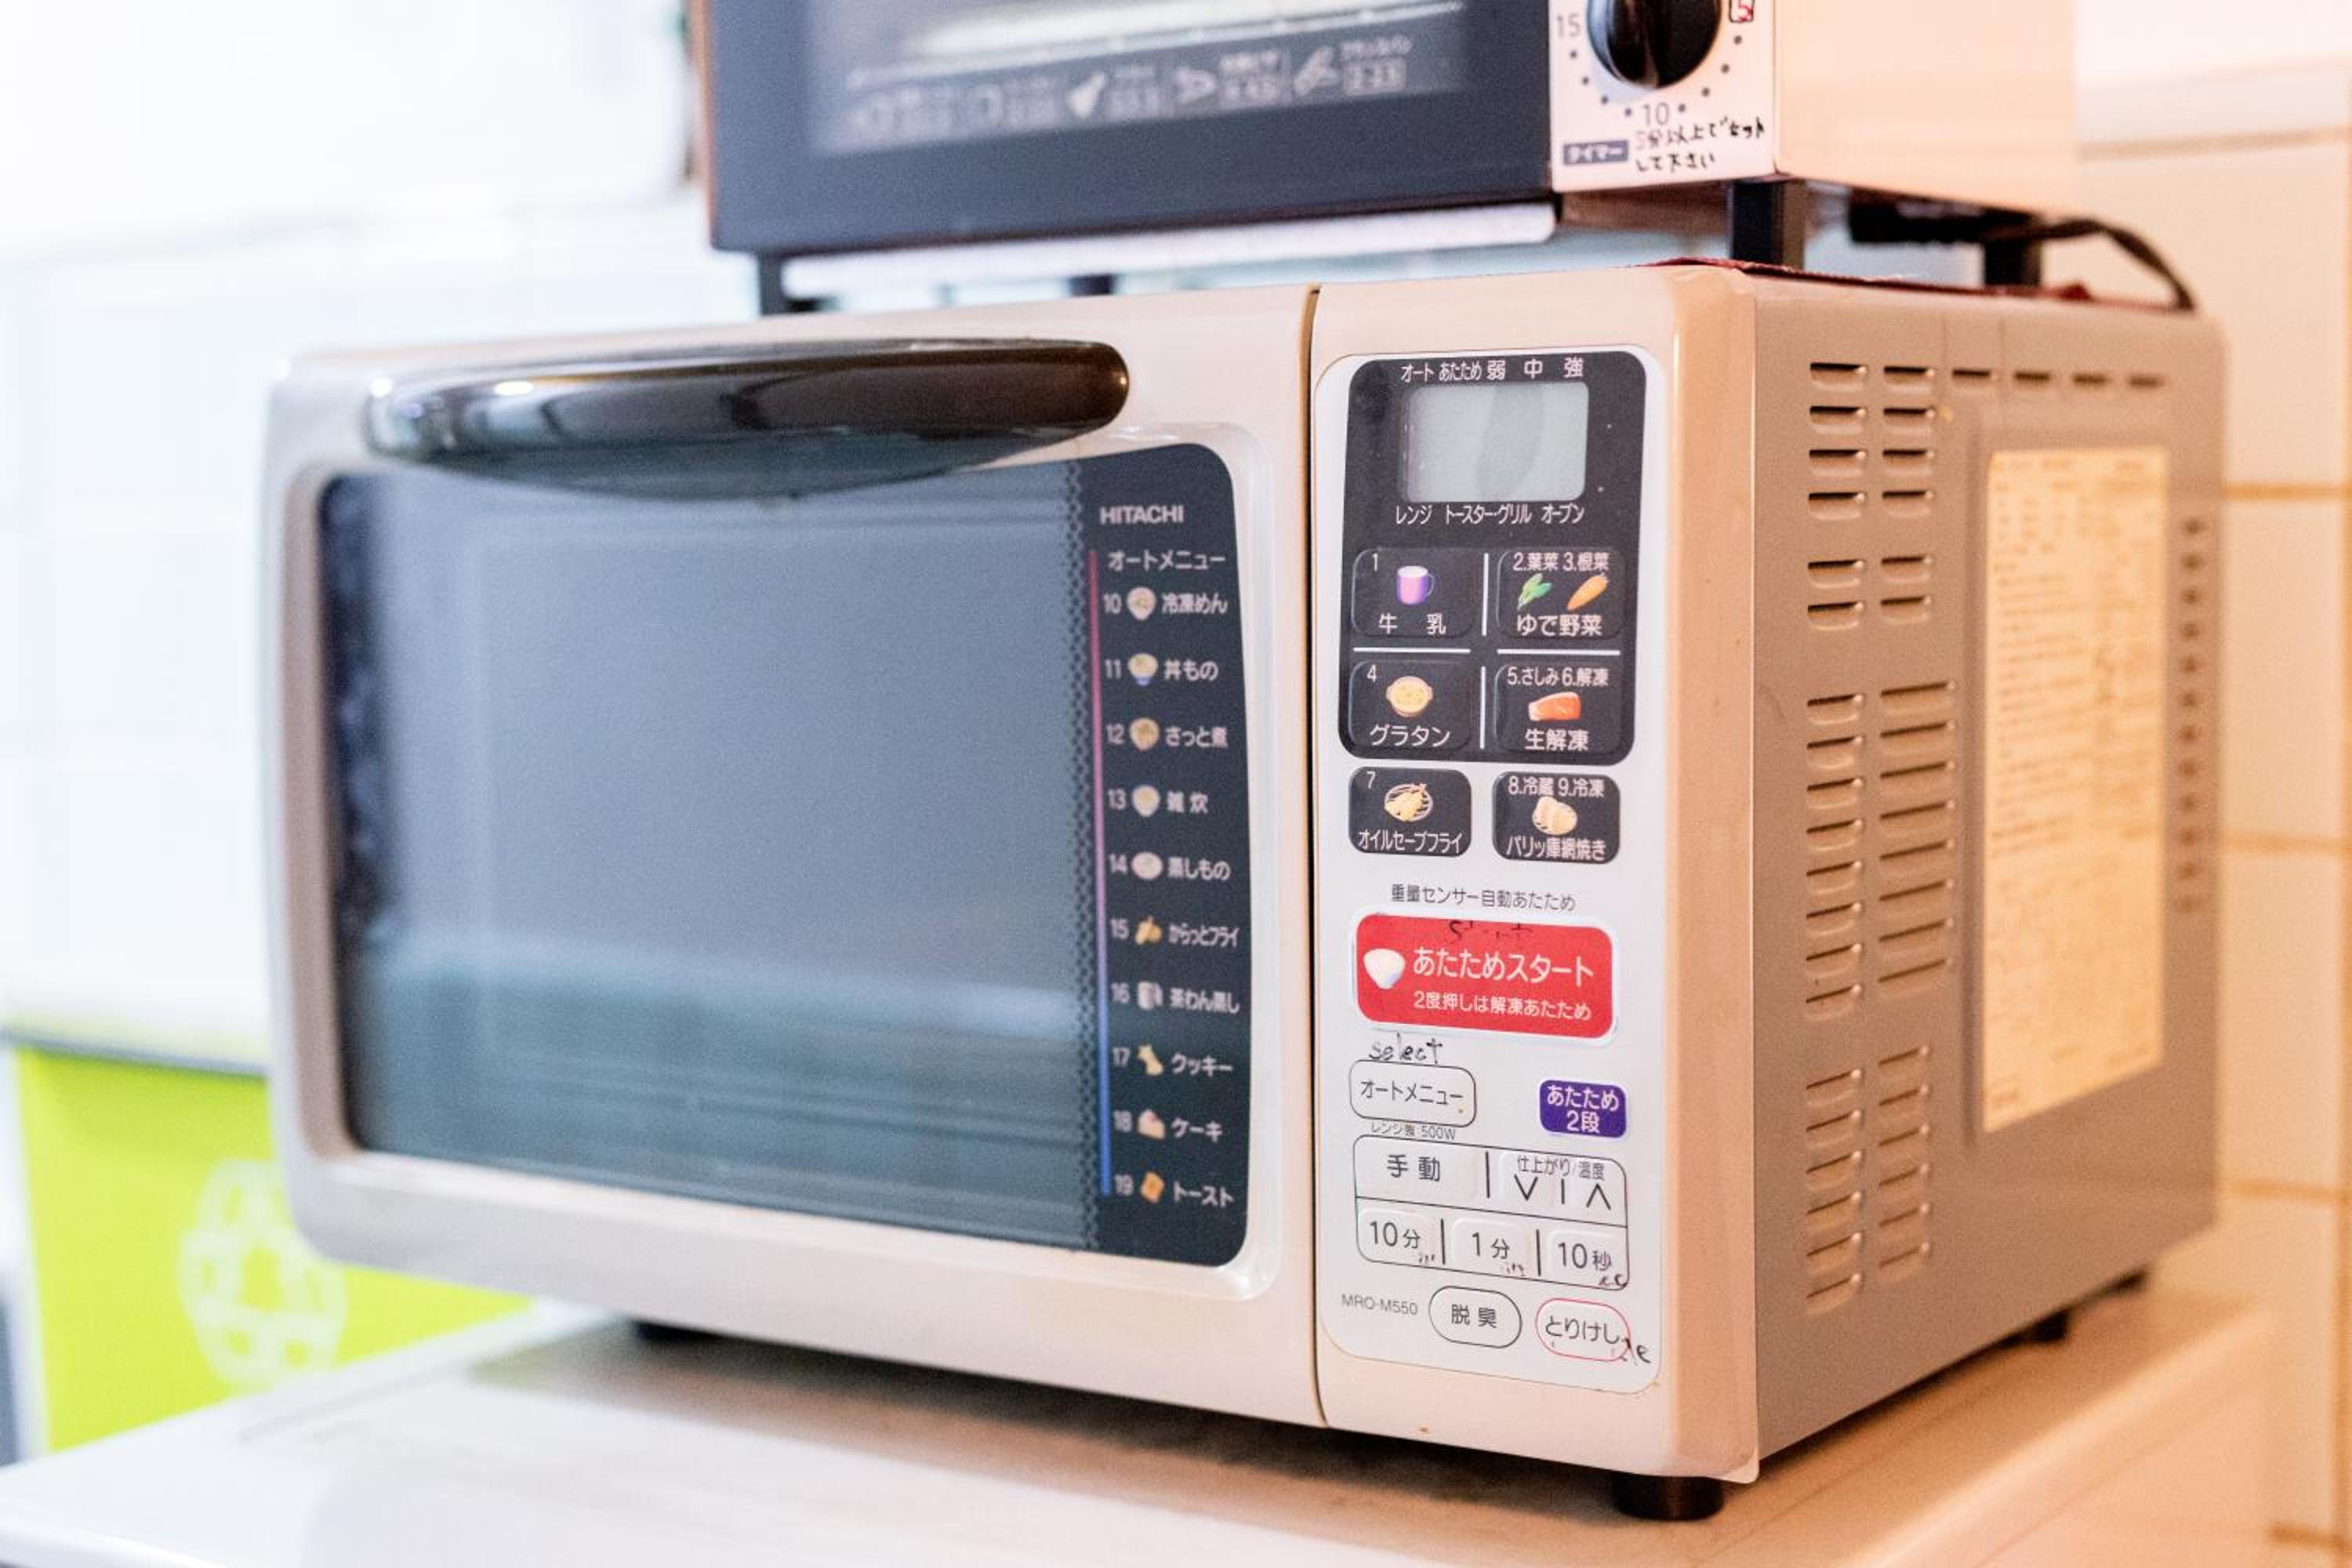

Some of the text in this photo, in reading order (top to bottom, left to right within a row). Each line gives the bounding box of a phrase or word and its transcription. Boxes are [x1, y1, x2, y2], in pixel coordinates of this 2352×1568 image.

[1556, 13, 1581, 38] 15
[1643, 102, 1669, 125] 10
[1401, 357, 1583, 383] オート あたため 弱 中 強
[1100, 505, 1185, 524] HITACHI
[1396, 505, 1432, 524] レンジ
[1542, 503, 1584, 524] オープン
[1108, 550, 1226, 572] オートメニュー
[1372, 554, 1379, 572] 1
[1103, 592, 1229, 615] 10 冷凍めん
[1517, 615, 1602, 637] ゆで野菜
[1105, 659, 1121, 678] 11
[1367, 666, 1377, 683] 4
[1508, 667, 1610, 687] 5.さしみ 6.解凍
[1106, 724, 1124, 744] 12
[1370, 725, 1450, 747] グラタン
[1525, 729, 1588, 752] 生解凍
[1367, 771, 1375, 789] 7
[1108, 789, 1126, 811] 13
[1358, 830, 1462, 854] オイルセーブフライ
[1109, 854, 1230, 880] 14 蒸しもの
[1392, 884, 1576, 911] 重量センサー自動あたため
[1110, 919, 1129, 939] 15
[1414, 946, 1595, 987] あたためスタート
[1414, 991, 1592, 1020] 2度押しは解凍あたため
[1172, 1053, 1232, 1076] クッキー
[1360, 1080, 1464, 1106] オートメニュー
[1547, 1085, 1619, 1111] あたため
[1171, 1118, 1223, 1142] ケーキ
[1421, 1125, 1456, 1141] 500W
[1566, 1111, 1600, 1134] 2段
[1387, 1154, 1440, 1182] 手動
[1174, 1180, 1234, 1207] トースト
[1370, 1221, 1421, 1249] 10分
[1558, 1242, 1612, 1271] 10秒
[1341, 1293, 1418, 1316] MRO-M550
[1451, 1304, 1497, 1328] 脱臭
[1545, 1316, 1619, 1344] とりけし
